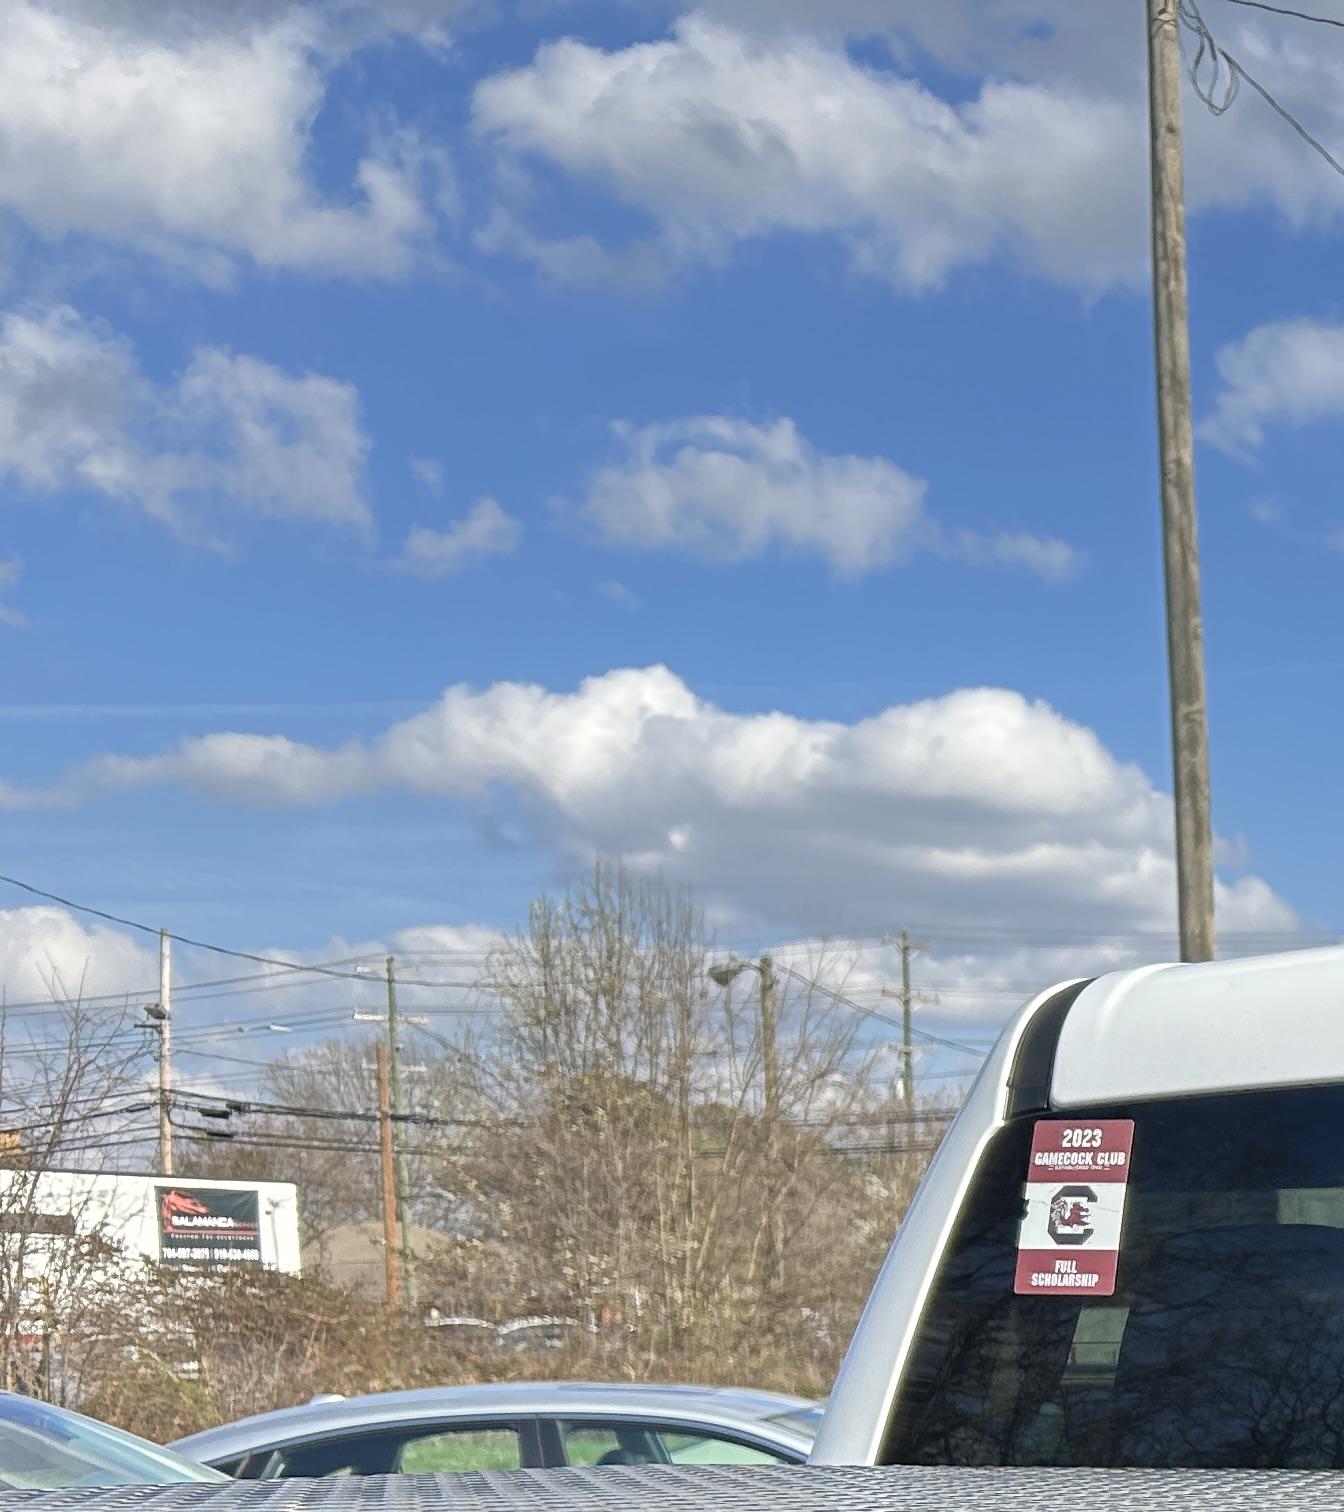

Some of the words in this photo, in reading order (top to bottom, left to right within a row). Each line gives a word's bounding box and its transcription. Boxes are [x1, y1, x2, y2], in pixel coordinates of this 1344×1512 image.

[1061, 1129, 1102, 1148] 2023
[1034, 1152, 1093, 1166] GAMECOCK
[1097, 1152, 1126, 1166] CLUB
[1055, 1260, 1078, 1274] FULL
[1031, 1273, 1099, 1288] SCHOLARSHIP
